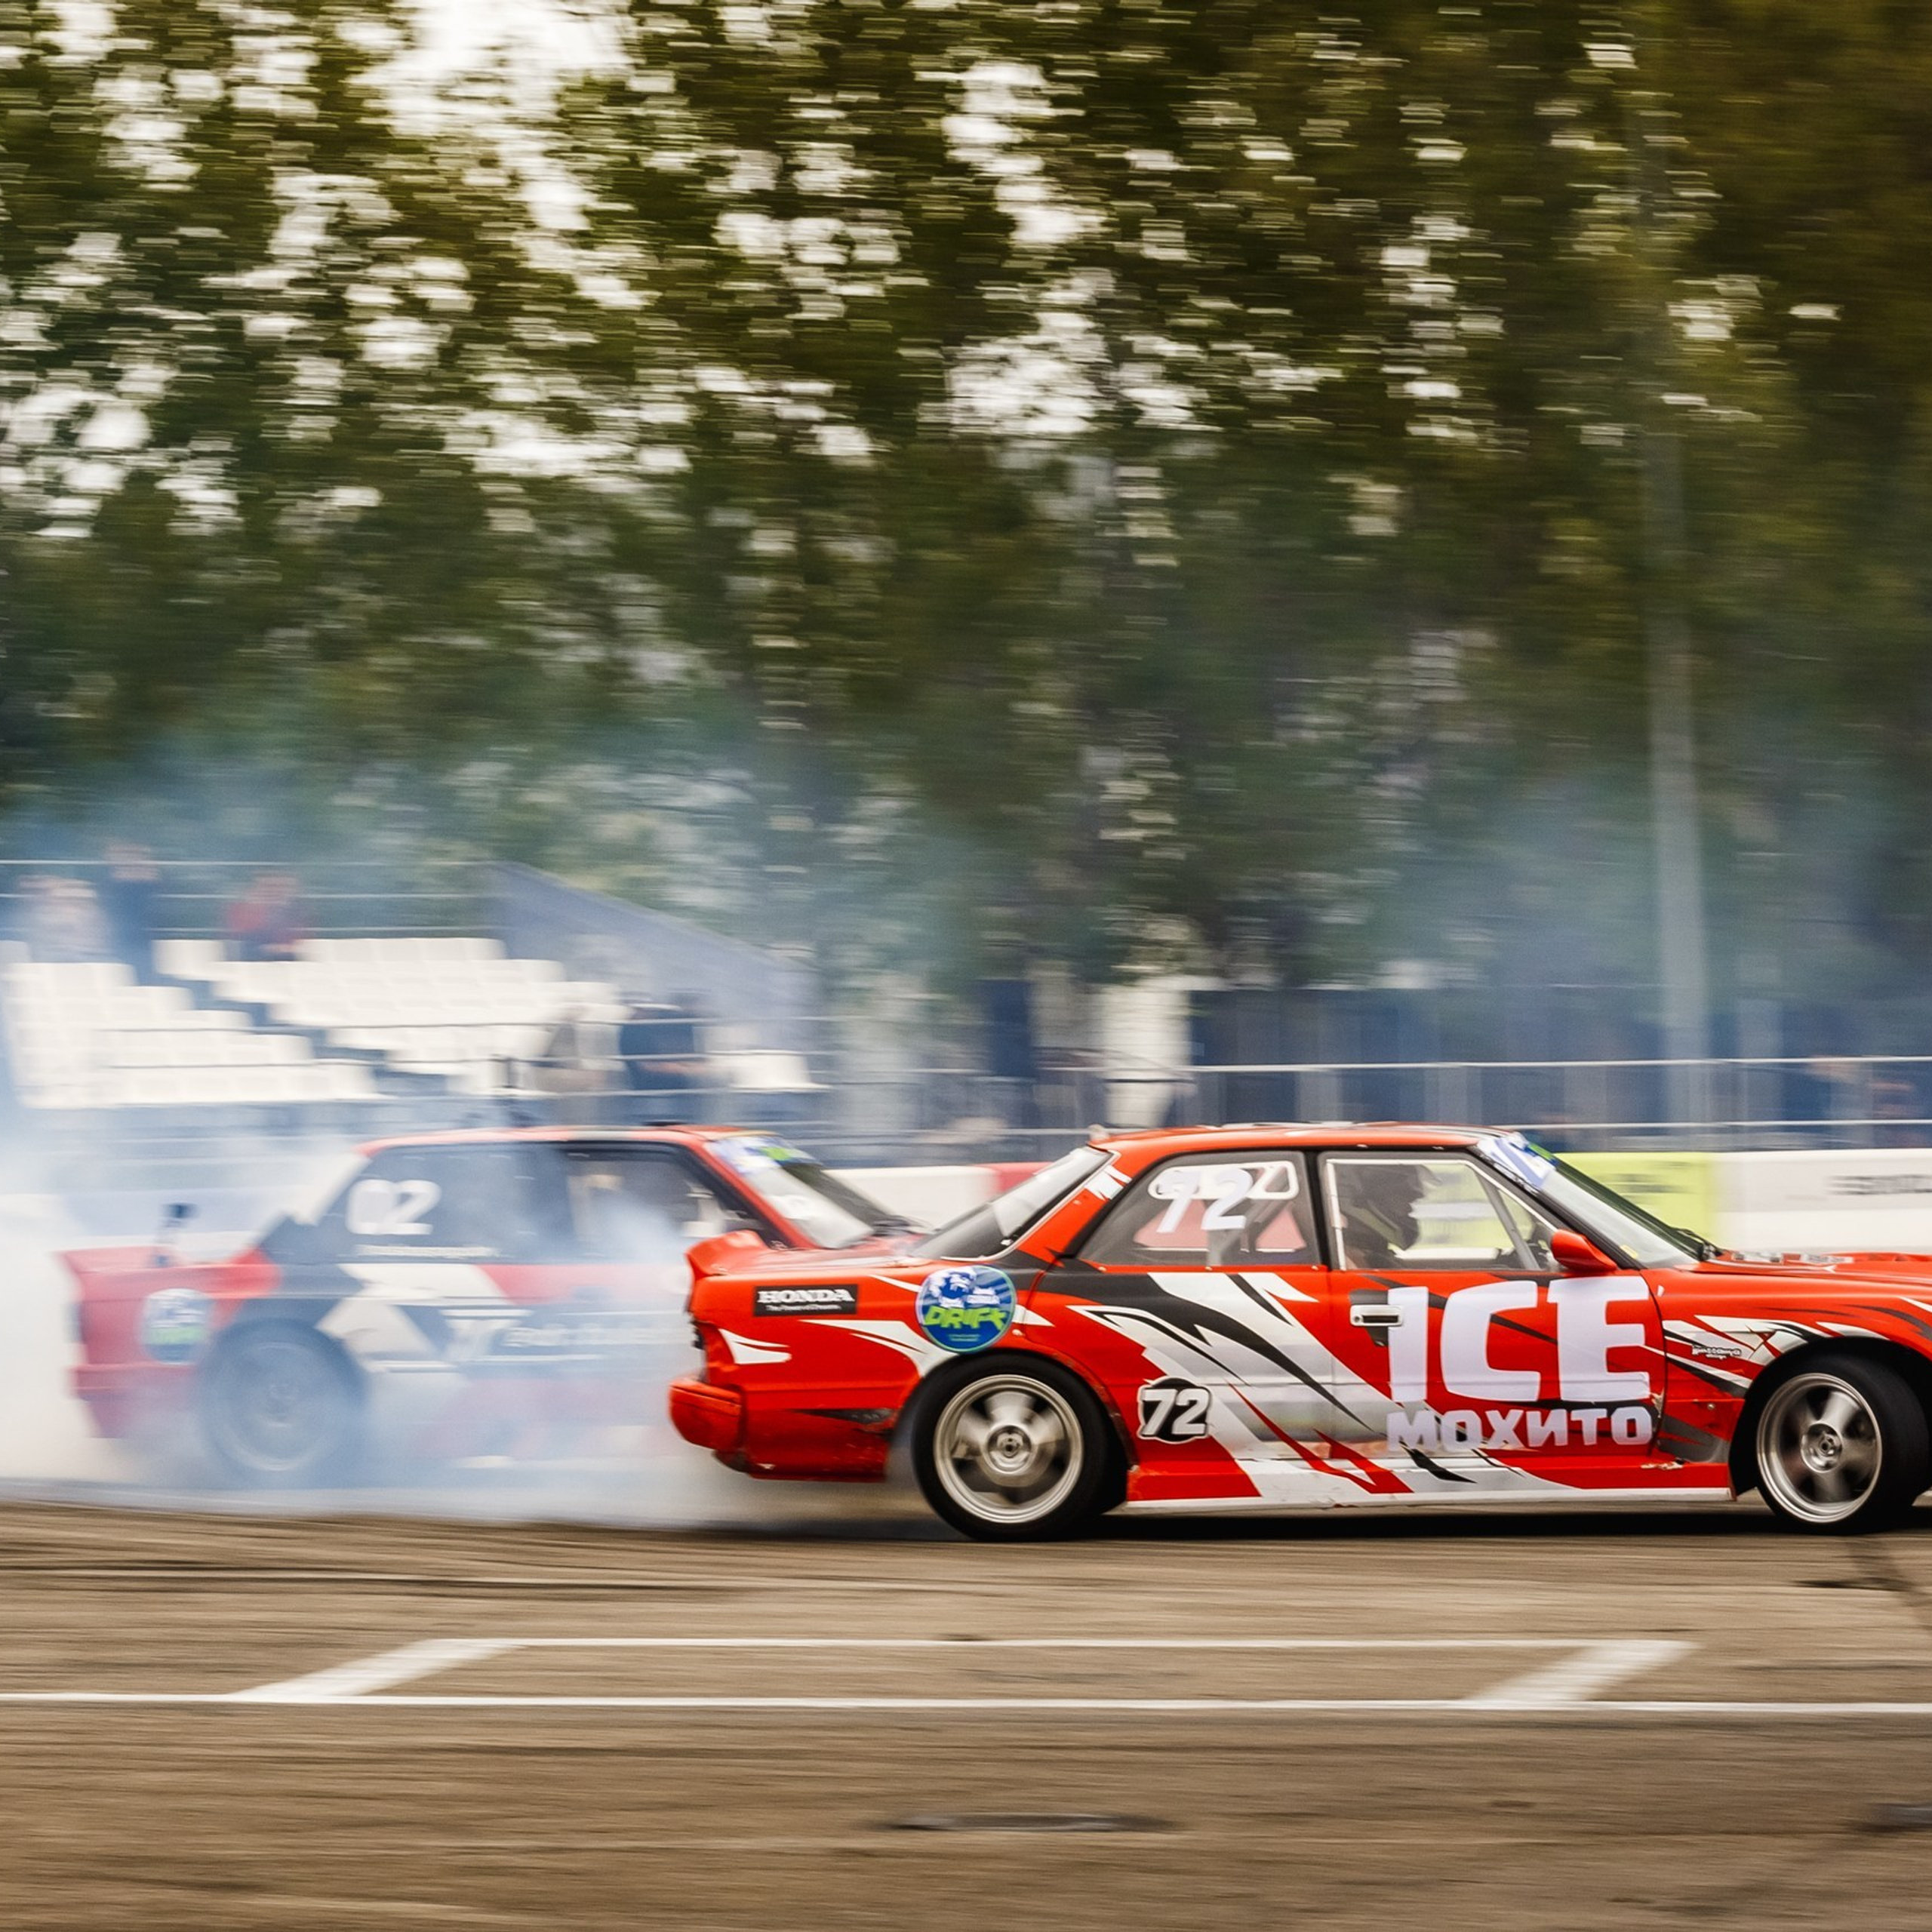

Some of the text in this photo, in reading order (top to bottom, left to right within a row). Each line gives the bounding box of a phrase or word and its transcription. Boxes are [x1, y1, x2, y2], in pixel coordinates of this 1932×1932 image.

[756, 1288, 855, 1303] HONDA
[924, 1305, 1007, 1331] DRIFT
[1387, 1275, 1651, 1402] ICE
[1140, 1388, 1210, 1435] 72
[1386, 1406, 1653, 1452] МОХИТО
